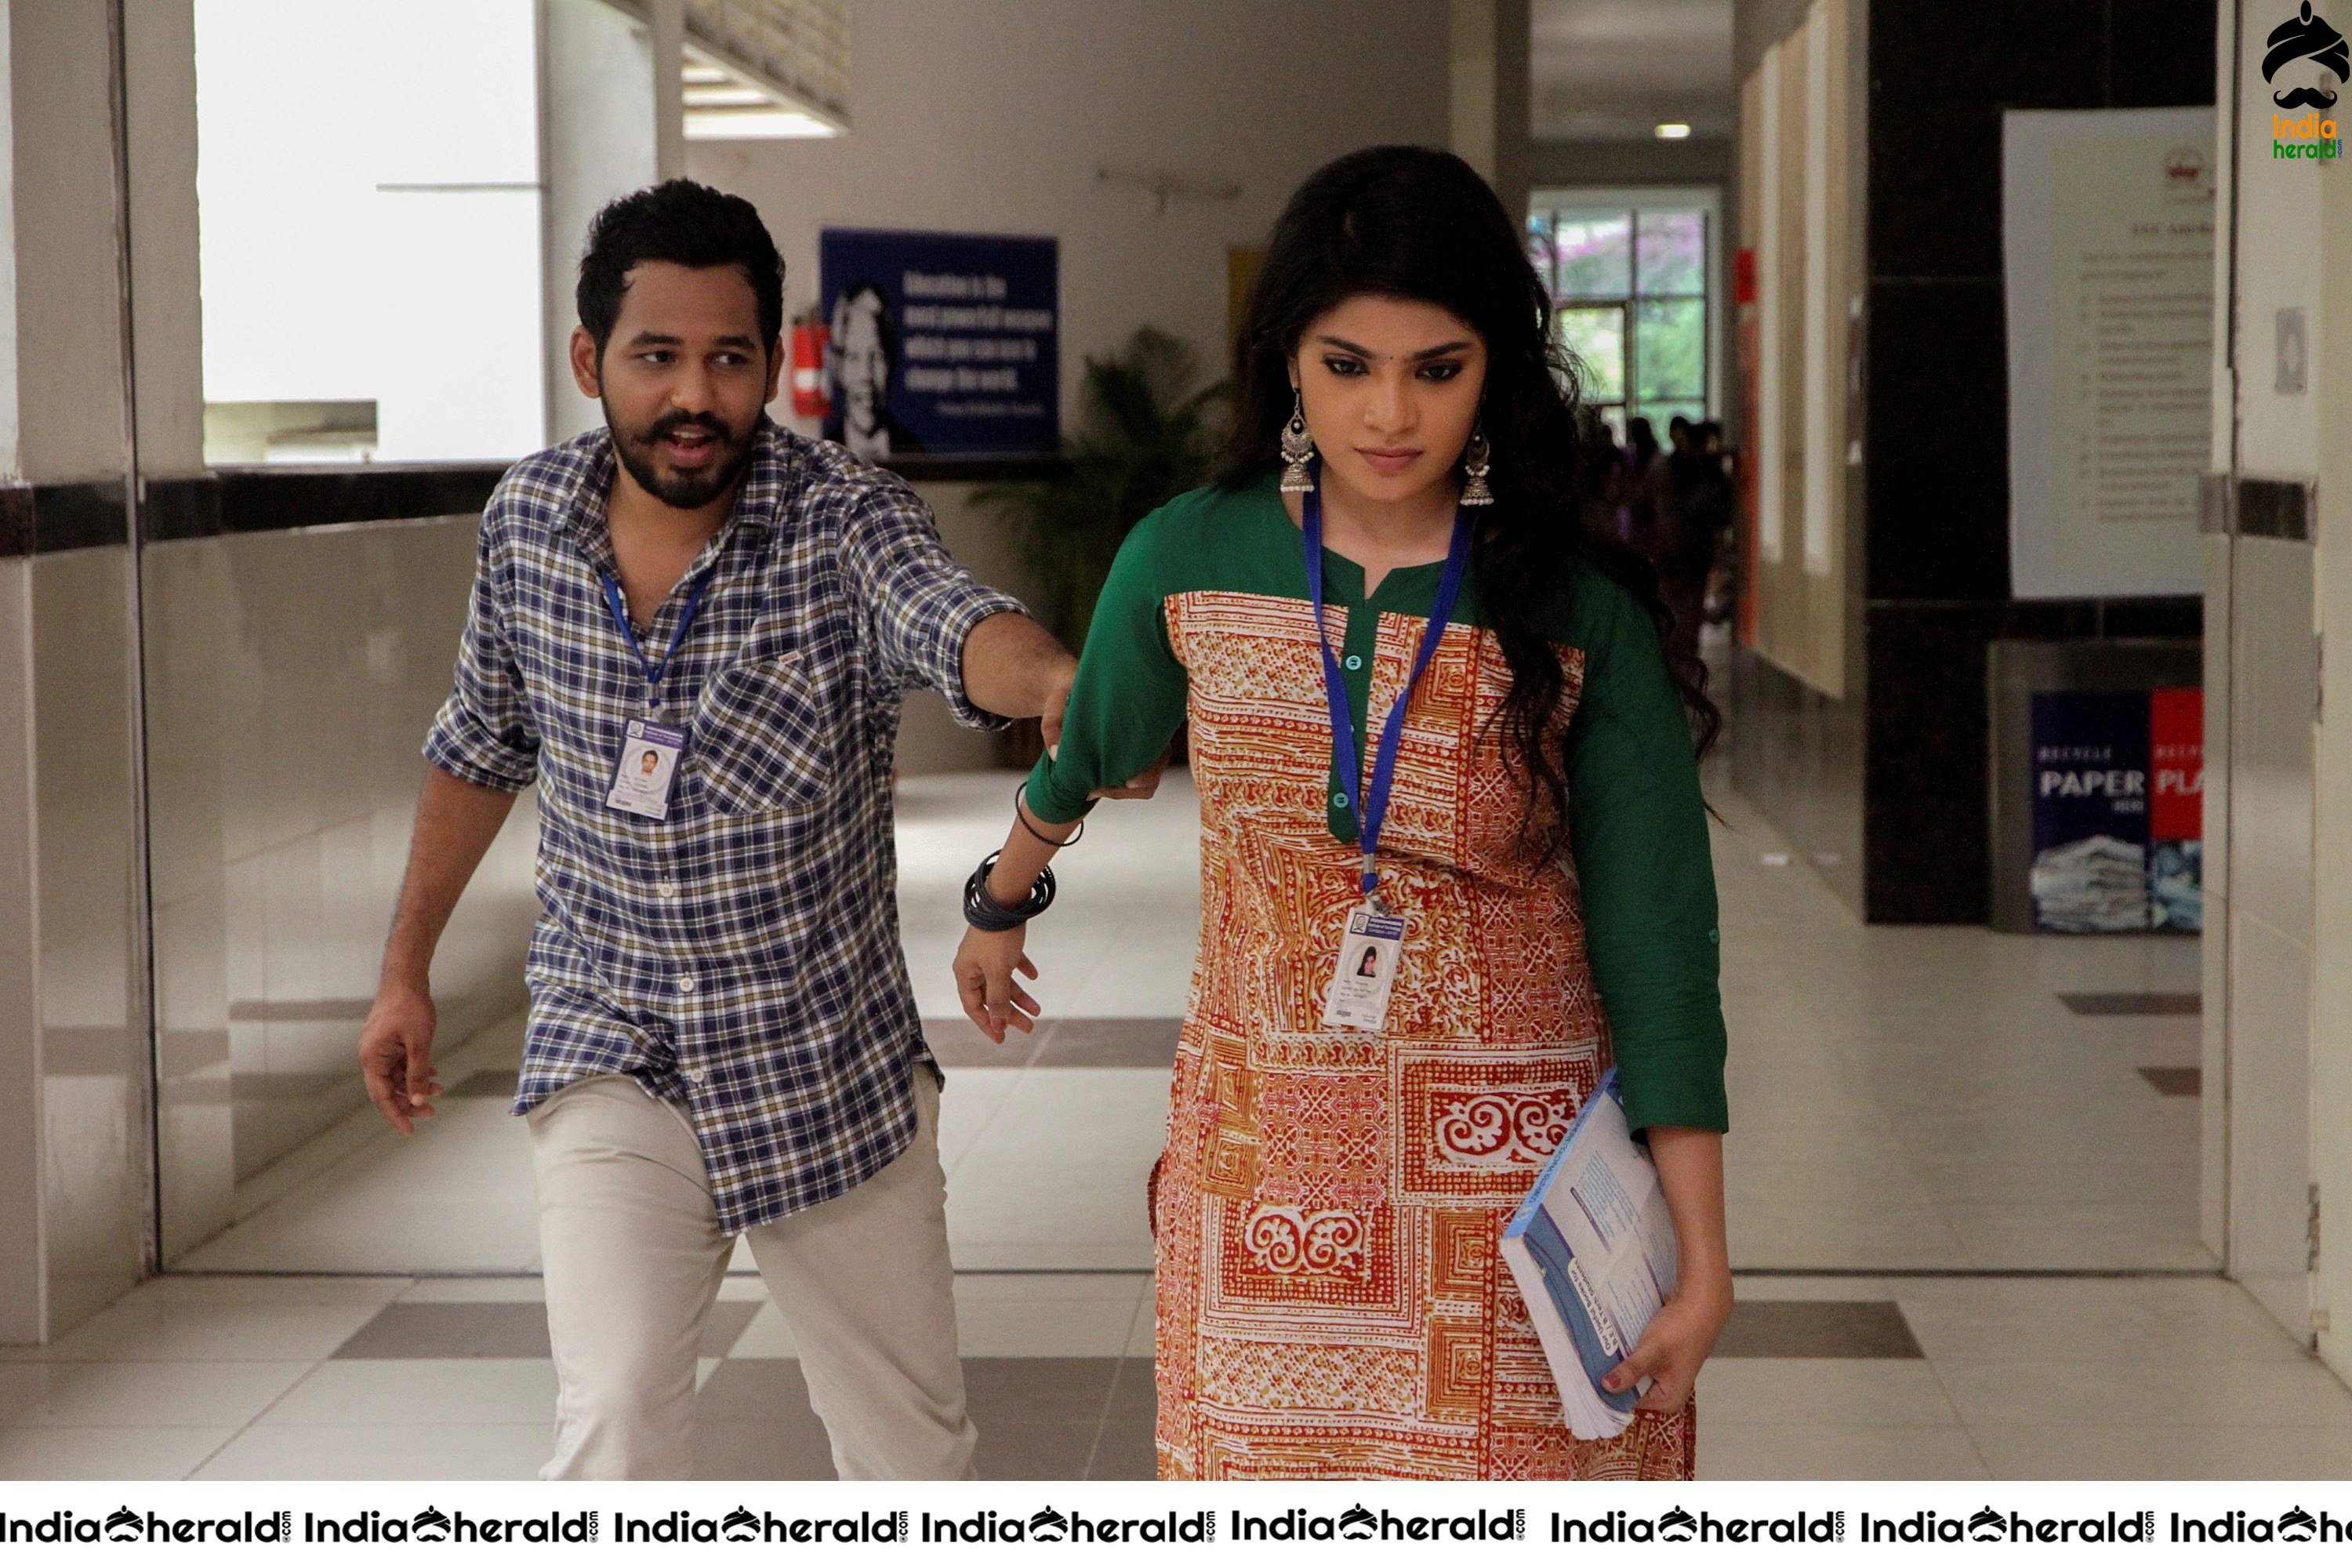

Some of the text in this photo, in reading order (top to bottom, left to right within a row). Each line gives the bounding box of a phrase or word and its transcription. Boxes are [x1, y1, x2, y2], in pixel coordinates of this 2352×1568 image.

[2040, 770, 2145, 797] PAPER
[1574, 1260, 1595, 1297] Students
[1578, 1282, 1592, 1308] Books
[1590, 1307, 1604, 1334] Useful
[1602, 1335, 1611, 1351] Our
